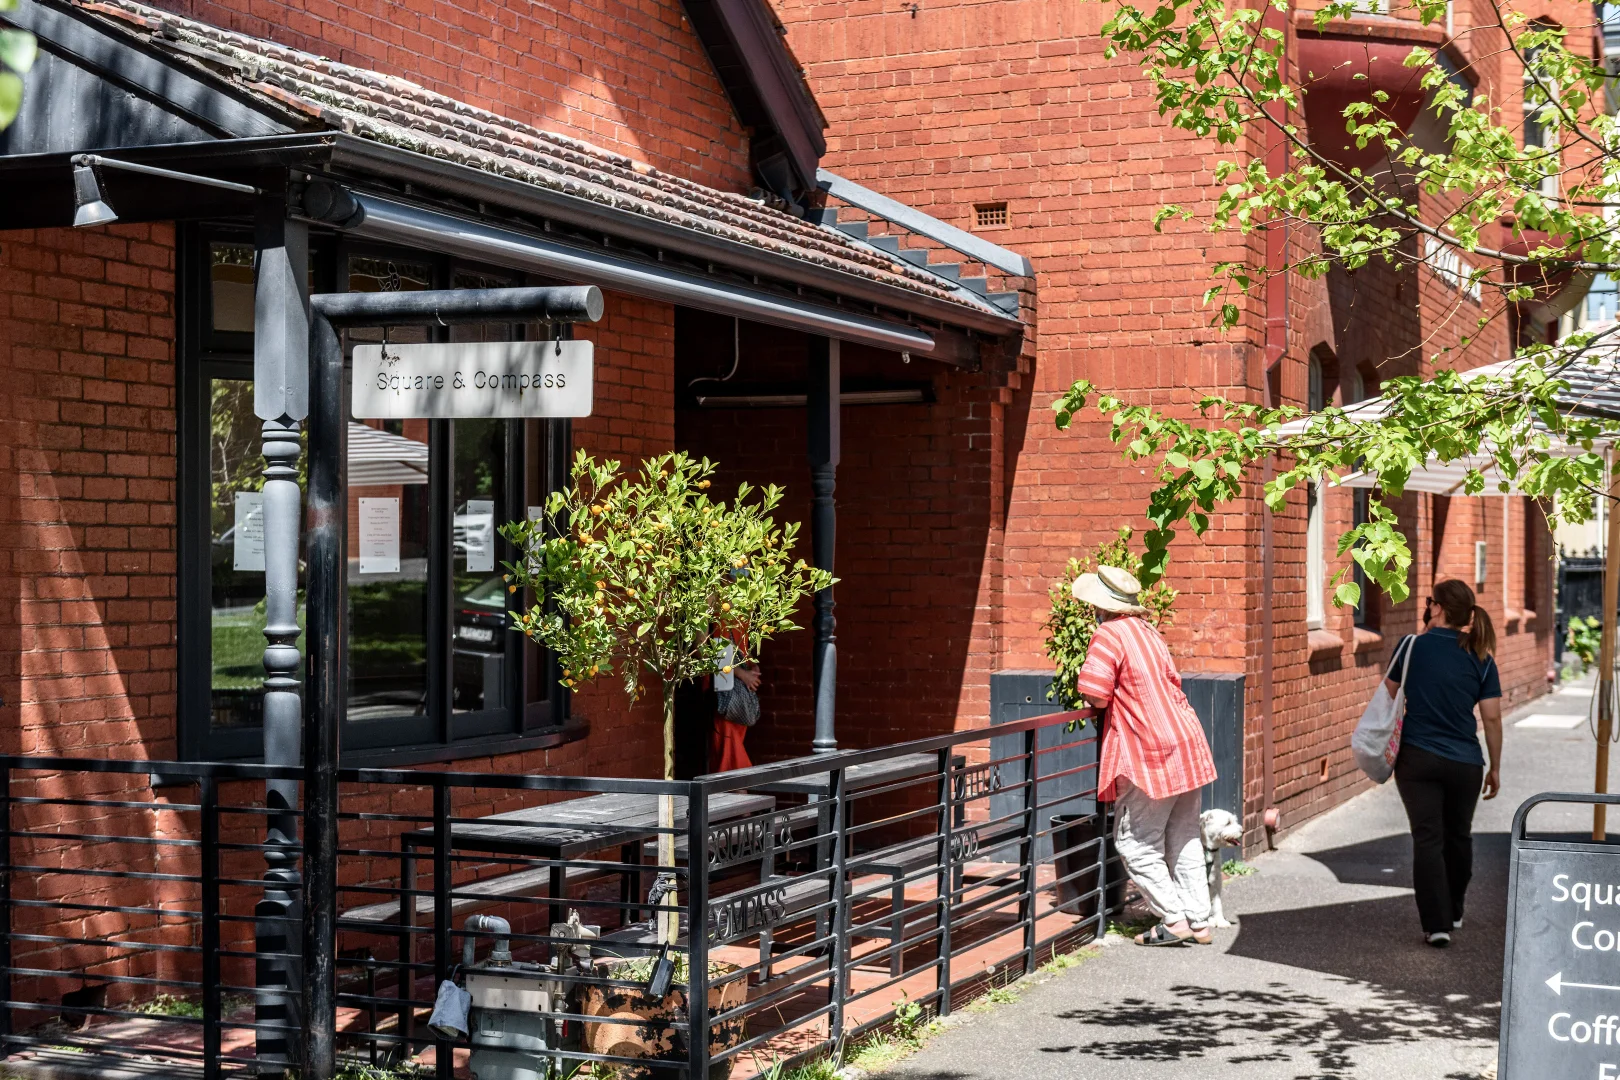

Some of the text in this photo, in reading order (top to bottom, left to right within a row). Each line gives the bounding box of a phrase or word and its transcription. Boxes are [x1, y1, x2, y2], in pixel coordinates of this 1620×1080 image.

[376, 370, 567, 395] Square & Compass
[780, 814, 794, 847] &
[1571, 921, 1620, 952] Co
[1547, 1012, 1620, 1046] Coff
